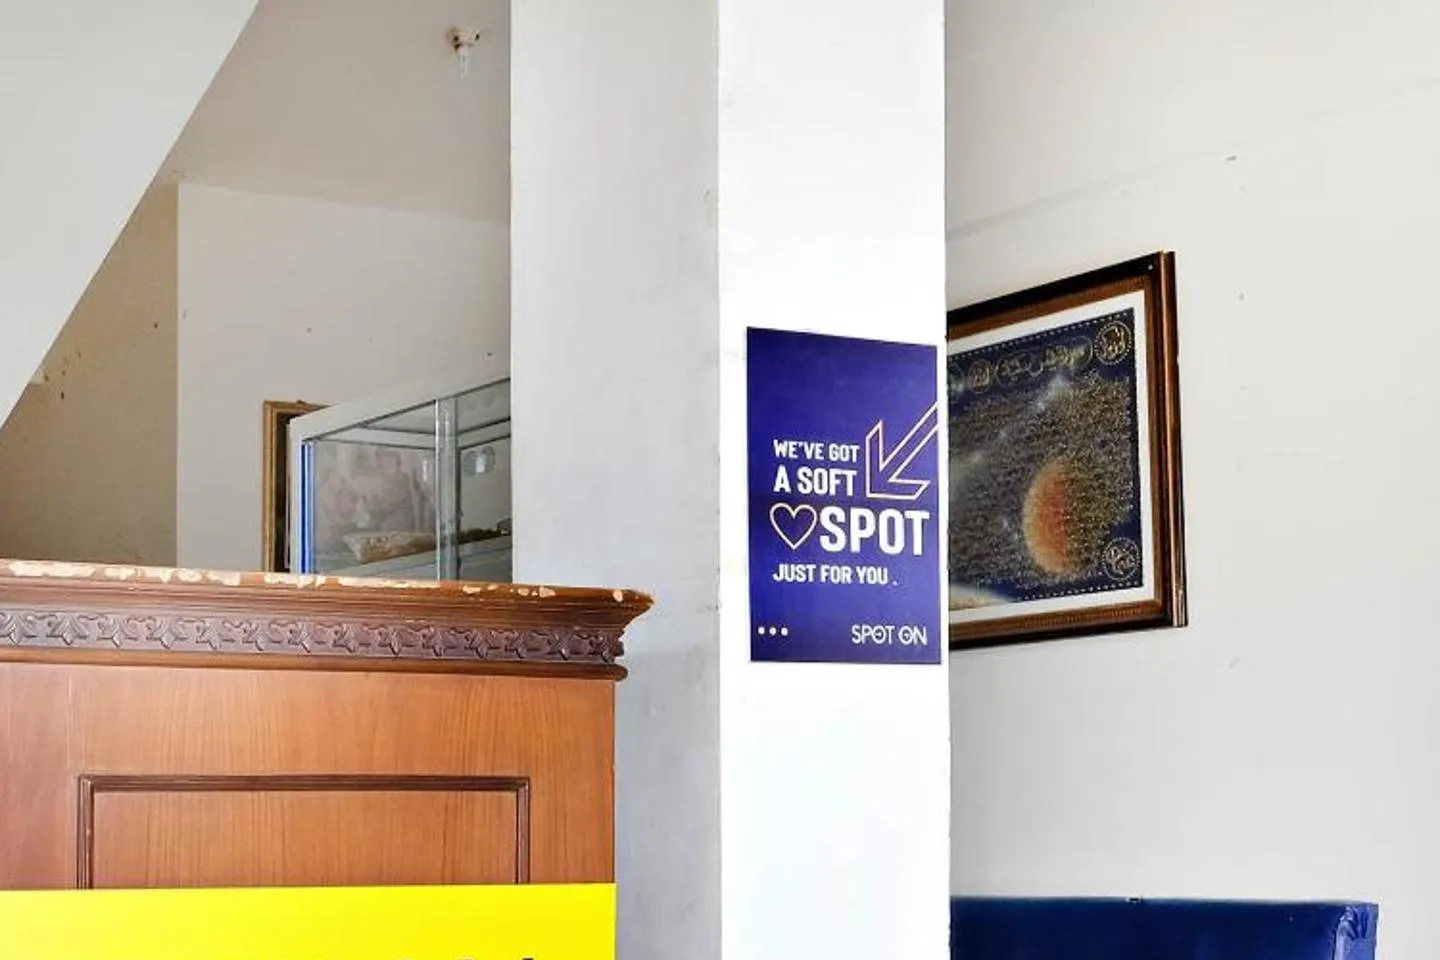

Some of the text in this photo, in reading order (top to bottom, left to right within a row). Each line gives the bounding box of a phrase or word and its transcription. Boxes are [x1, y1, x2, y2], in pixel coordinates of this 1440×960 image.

[773, 439, 860, 463] WE'VE GOT
[773, 465, 858, 496] A SOFT
[819, 505, 930, 556] SPOT
[772, 564, 816, 583] JUST
[820, 565, 852, 584] FOR
[851, 624, 928, 646] SPOT ON
